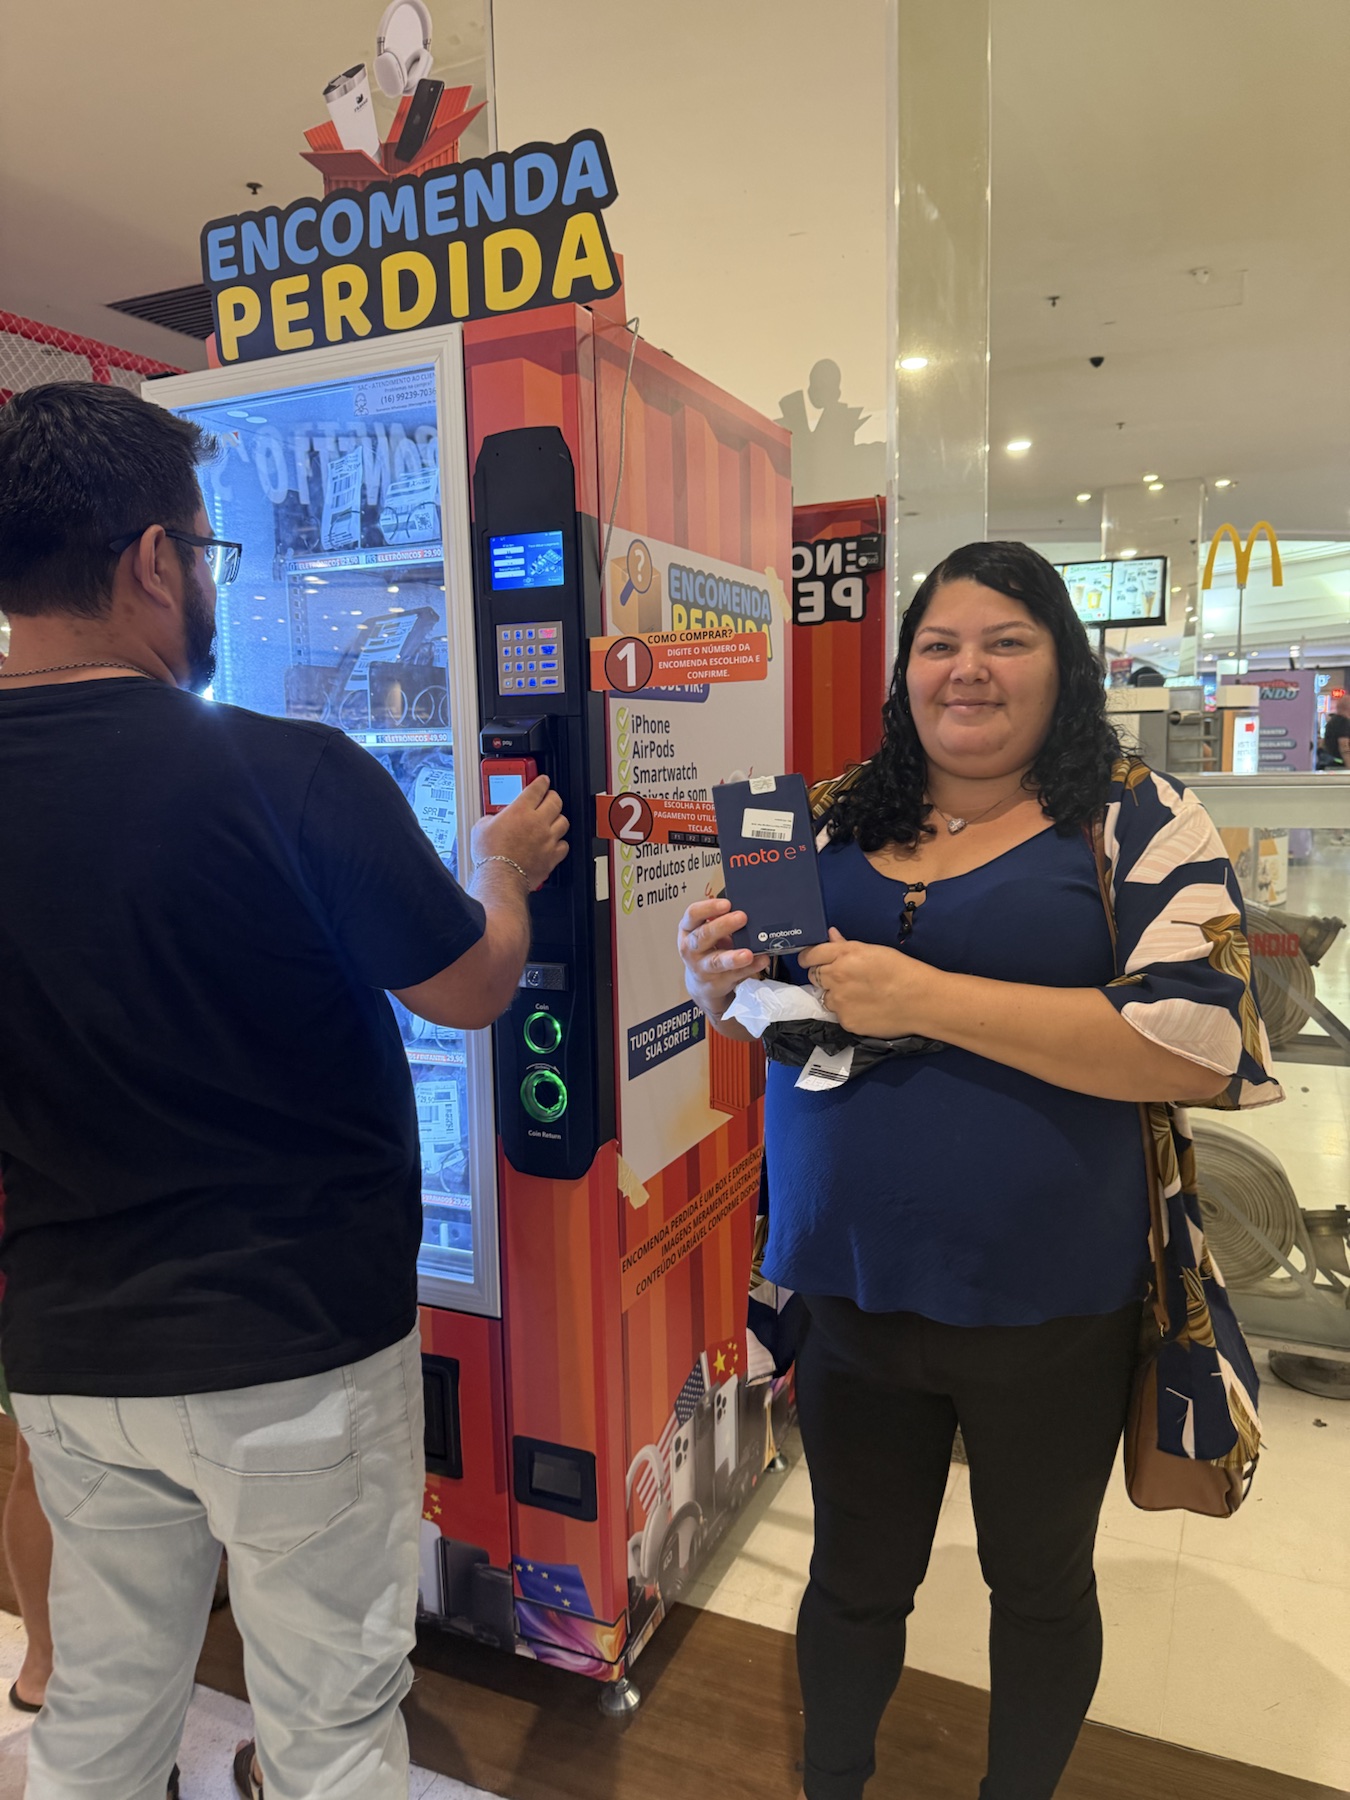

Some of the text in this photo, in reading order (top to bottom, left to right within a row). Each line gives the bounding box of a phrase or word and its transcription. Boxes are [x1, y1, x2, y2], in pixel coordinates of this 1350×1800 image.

[207, 140, 608, 282] ENCOMENDA
[216, 212, 614, 361] PERDIDA
[371, 376, 411, 390] ATENDIMENTO
[381, 395, 395, 405] (16)
[377, 550, 422, 562] ELETRÔNICOS
[670, 568, 771, 621] ENCOMENDA
[647, 628, 733, 644] COMO COMPRAR?
[667, 643, 751, 657] DIGITE O NÚMERO DA
[616, 642, 637, 687] 1
[658, 655, 760, 670] ENCOMENDA ESCOLHIDA E
[687, 669, 730, 680] CONFIRME.
[631, 714, 671, 734] iPhone
[384, 734, 428, 743] ELETRÔNICOS
[632, 740, 675, 760] AirPods
[633, 762, 698, 784] Smartwatch
[672, 786, 685, 800] de
[688, 788, 707, 801] som
[664, 800, 694, 809] ESCOLHA
[618, 797, 644, 840] 2
[653, 811, 696, 821] PAGAMENTO
[688, 824, 714, 833] TECLAS.
[636, 842, 669, 859] Smart
[729, 848, 780, 869] moto
[636, 850, 721, 884] Produtos de luxo
[637, 883, 687, 908] e muito +
[769, 928, 802, 939] motorola
[1249, 933, 1299, 958] NDIO
[535, 1003, 549, 1011] Coin
[630, 1006, 704, 1051] TUDO DEPENDE DA
[645, 1026, 690, 1061] SUA SORTE!
[528, 1129, 562, 1140] Coin Return
[622, 1226, 670, 1274] ENCOMENDA
[670, 1201, 699, 1233] PERDIDA
[704, 1187, 714, 1203] UM
[715, 1175, 727, 1194] BOX
[661, 1222, 692, 1257] IMAGENS
[693, 1192, 729, 1227] MERAMENTE
[636, 1252, 677, 1296] CONTEÚDO
[677, 1228, 708, 1259] VARIÁVEL
[708, 1198, 740, 1231] CONFORME
